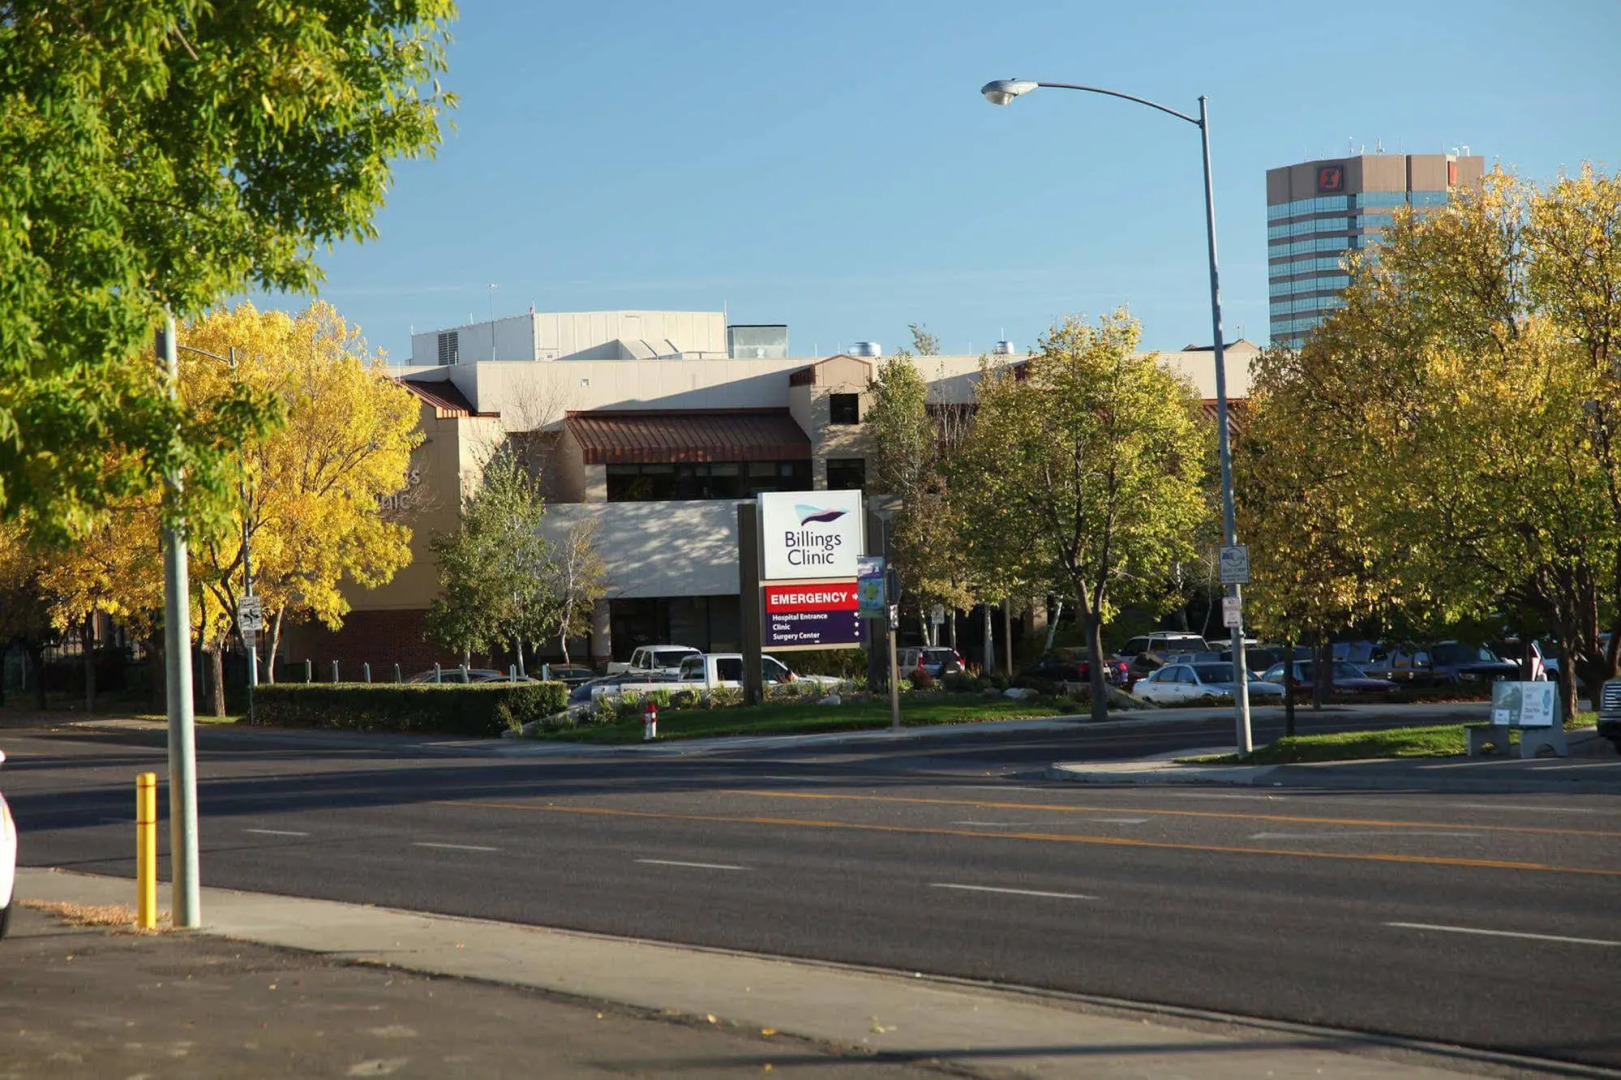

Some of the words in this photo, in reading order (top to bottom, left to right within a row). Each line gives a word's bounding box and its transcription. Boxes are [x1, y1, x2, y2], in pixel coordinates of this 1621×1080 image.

[785, 531, 842, 551] Billings
[788, 549, 834, 565] Clinic
[771, 592, 848, 605] EMERGENCY
[772, 613, 799, 622] Hospital
[772, 623, 790, 631] Clinic
[773, 633, 798, 641] Surgery
